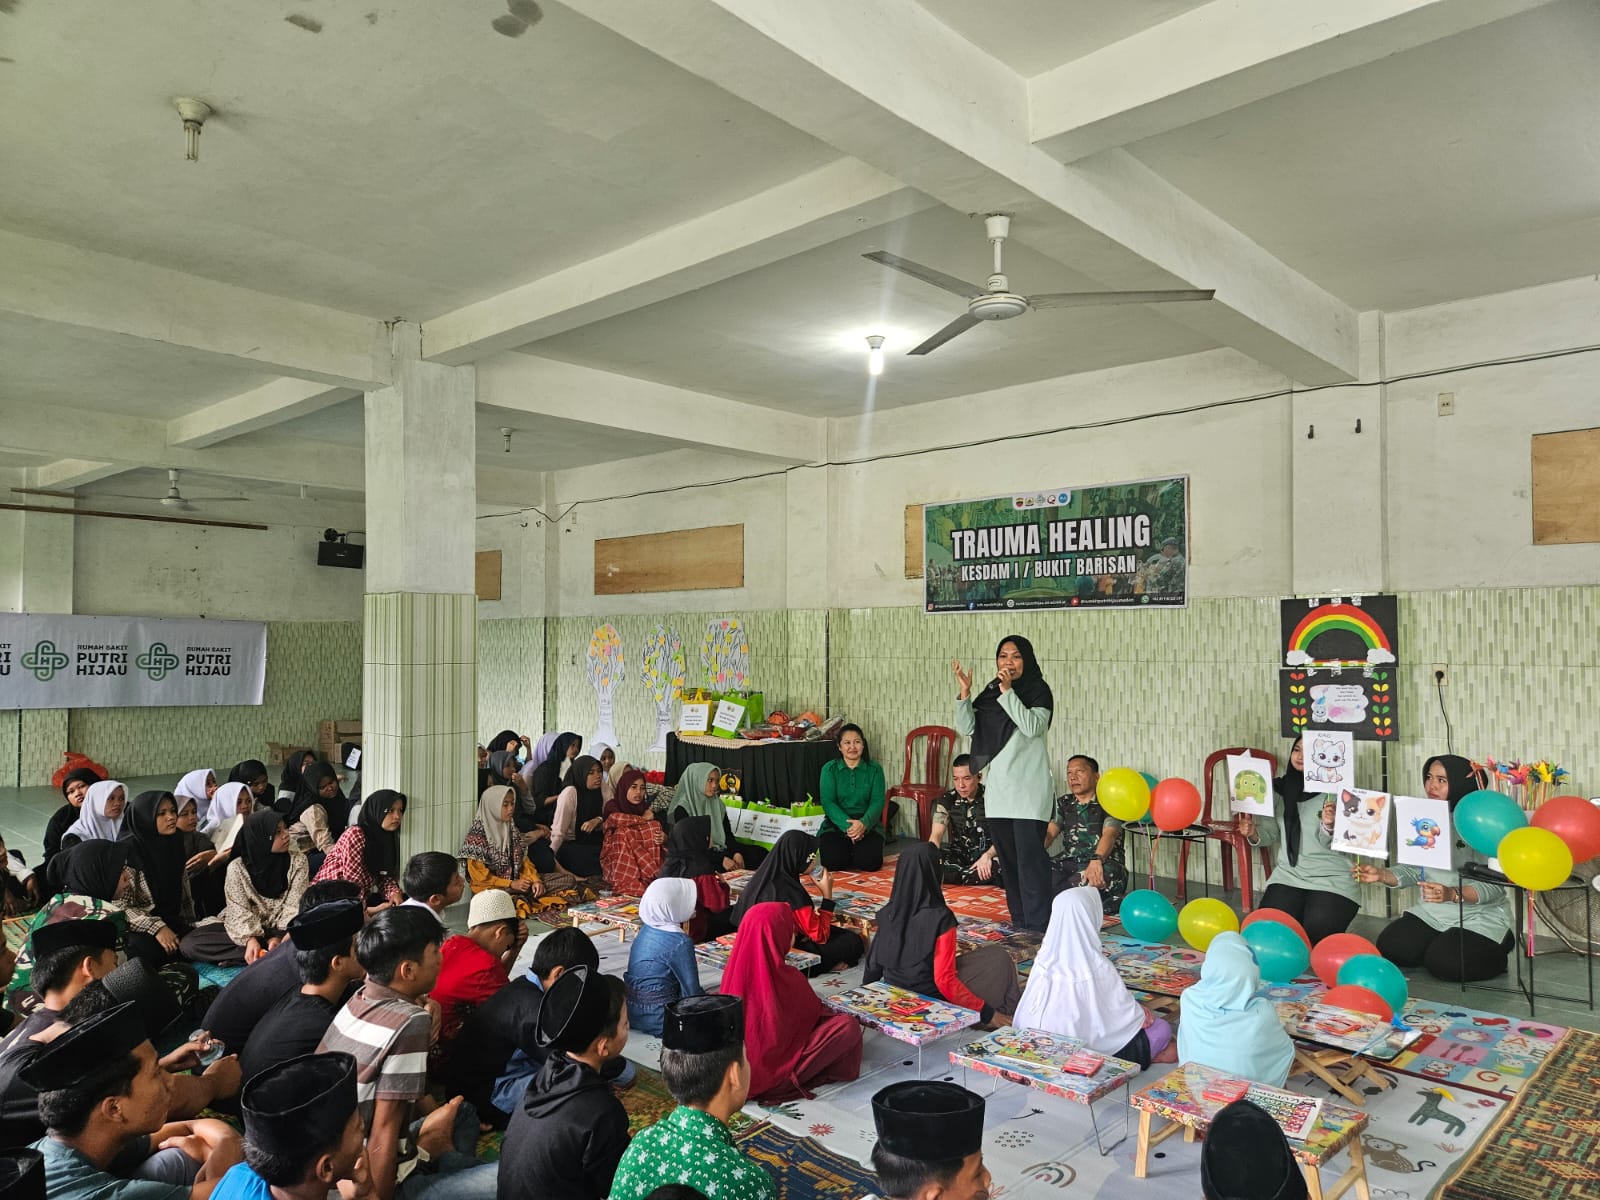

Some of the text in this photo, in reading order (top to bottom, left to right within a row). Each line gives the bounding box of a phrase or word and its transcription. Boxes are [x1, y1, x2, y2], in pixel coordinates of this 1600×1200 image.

[952, 515, 1151, 559] TRAUMA HEALING
[961, 563, 1010, 581] KESDAM
[1034, 559, 1071, 577] BUKIT
[1076, 555, 1136, 576] BARISAN
[77, 653, 128, 663] PUTRI
[186, 654, 231, 665] PUTRI
[76, 665, 128, 676] HIJAU
[185, 665, 231, 676] HIJAU
[1476, 1070, 1502, 1083] G
